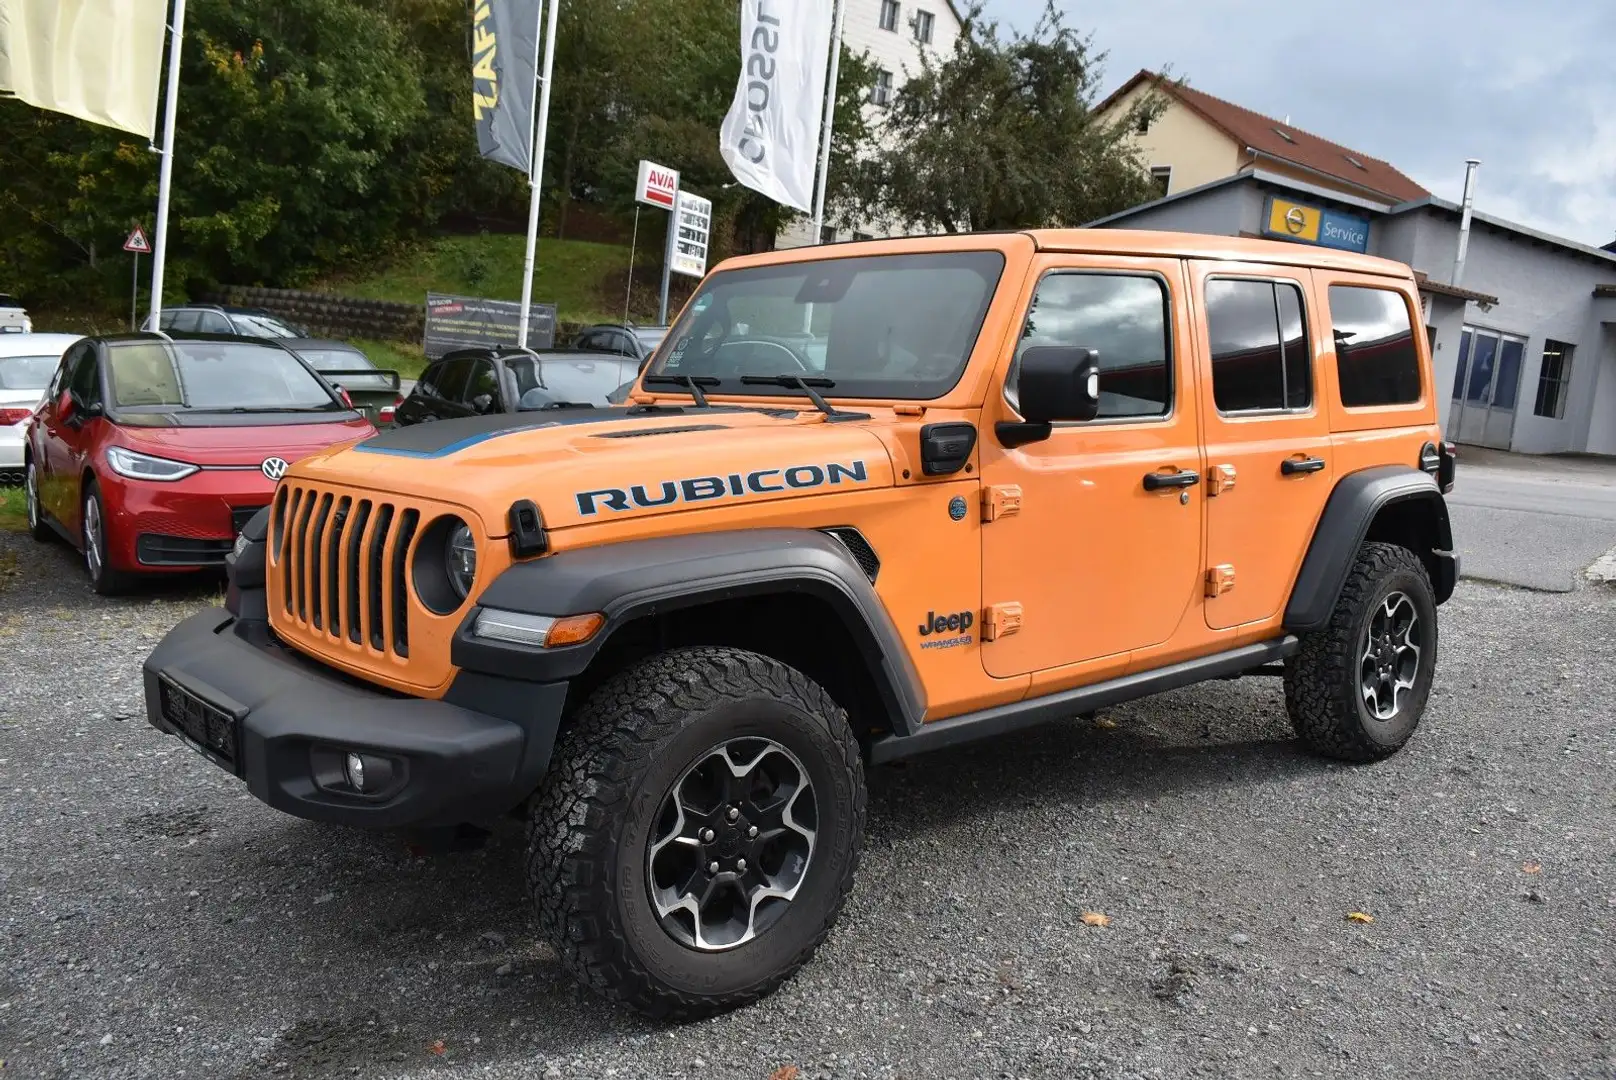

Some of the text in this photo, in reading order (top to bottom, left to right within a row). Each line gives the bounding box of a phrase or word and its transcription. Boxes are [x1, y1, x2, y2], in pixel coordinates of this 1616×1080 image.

[648, 170, 675, 190] AVIA
[1324, 222, 1364, 244] Service
[575, 460, 868, 516] RUBICON
[918, 610, 973, 637] Jeep
[920, 635, 972, 649] WRANGLER
